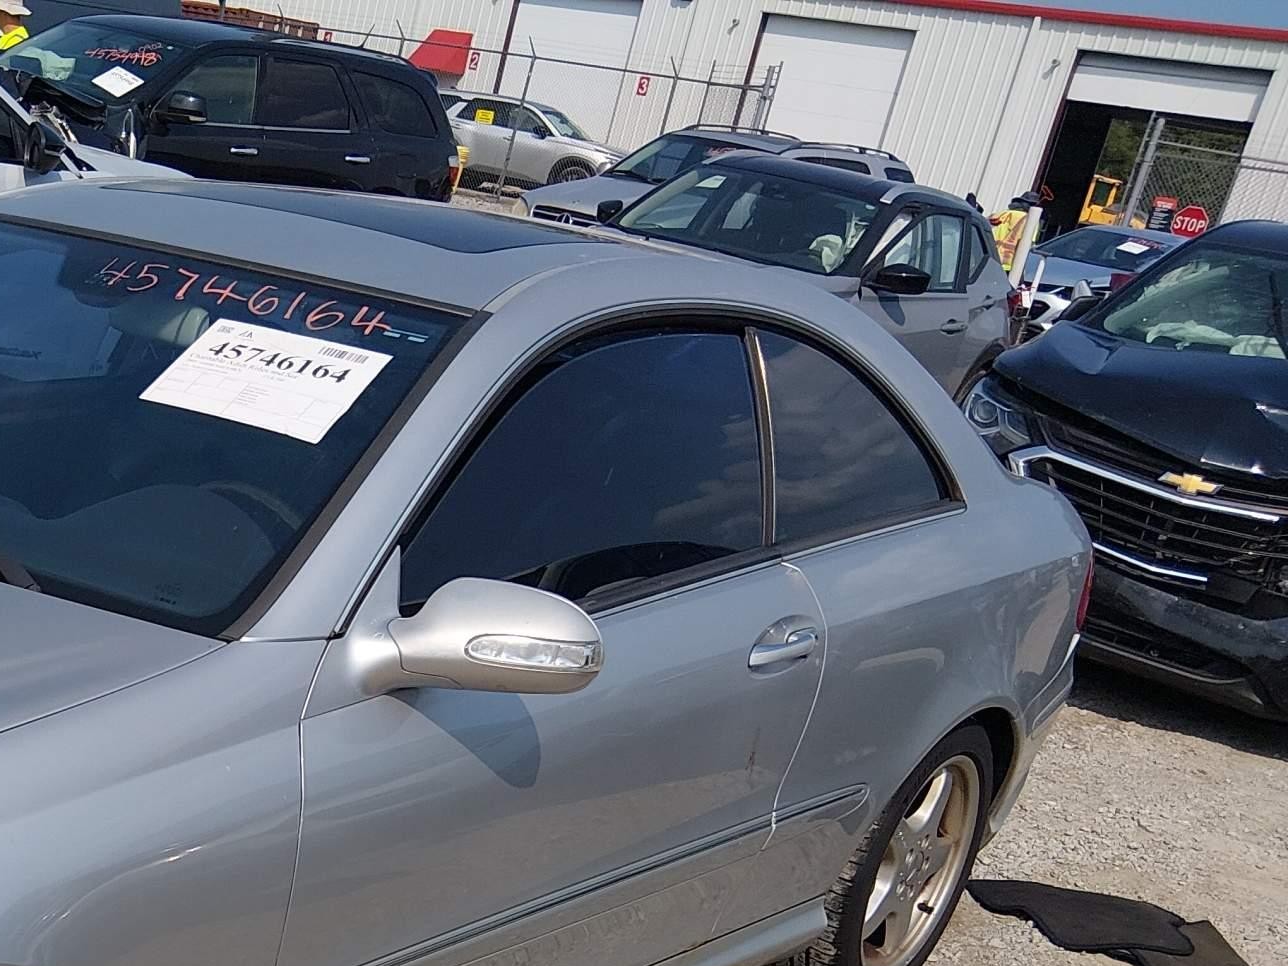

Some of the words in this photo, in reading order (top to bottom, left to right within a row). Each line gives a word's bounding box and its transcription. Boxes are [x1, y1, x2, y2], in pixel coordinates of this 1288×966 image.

[470, 54, 479, 69] 2
[639, 78, 649, 94] 3
[1173, 215, 1206, 233] STOP
[99, 257, 392, 336] 45746164
[209, 341, 352, 384] 45746164
